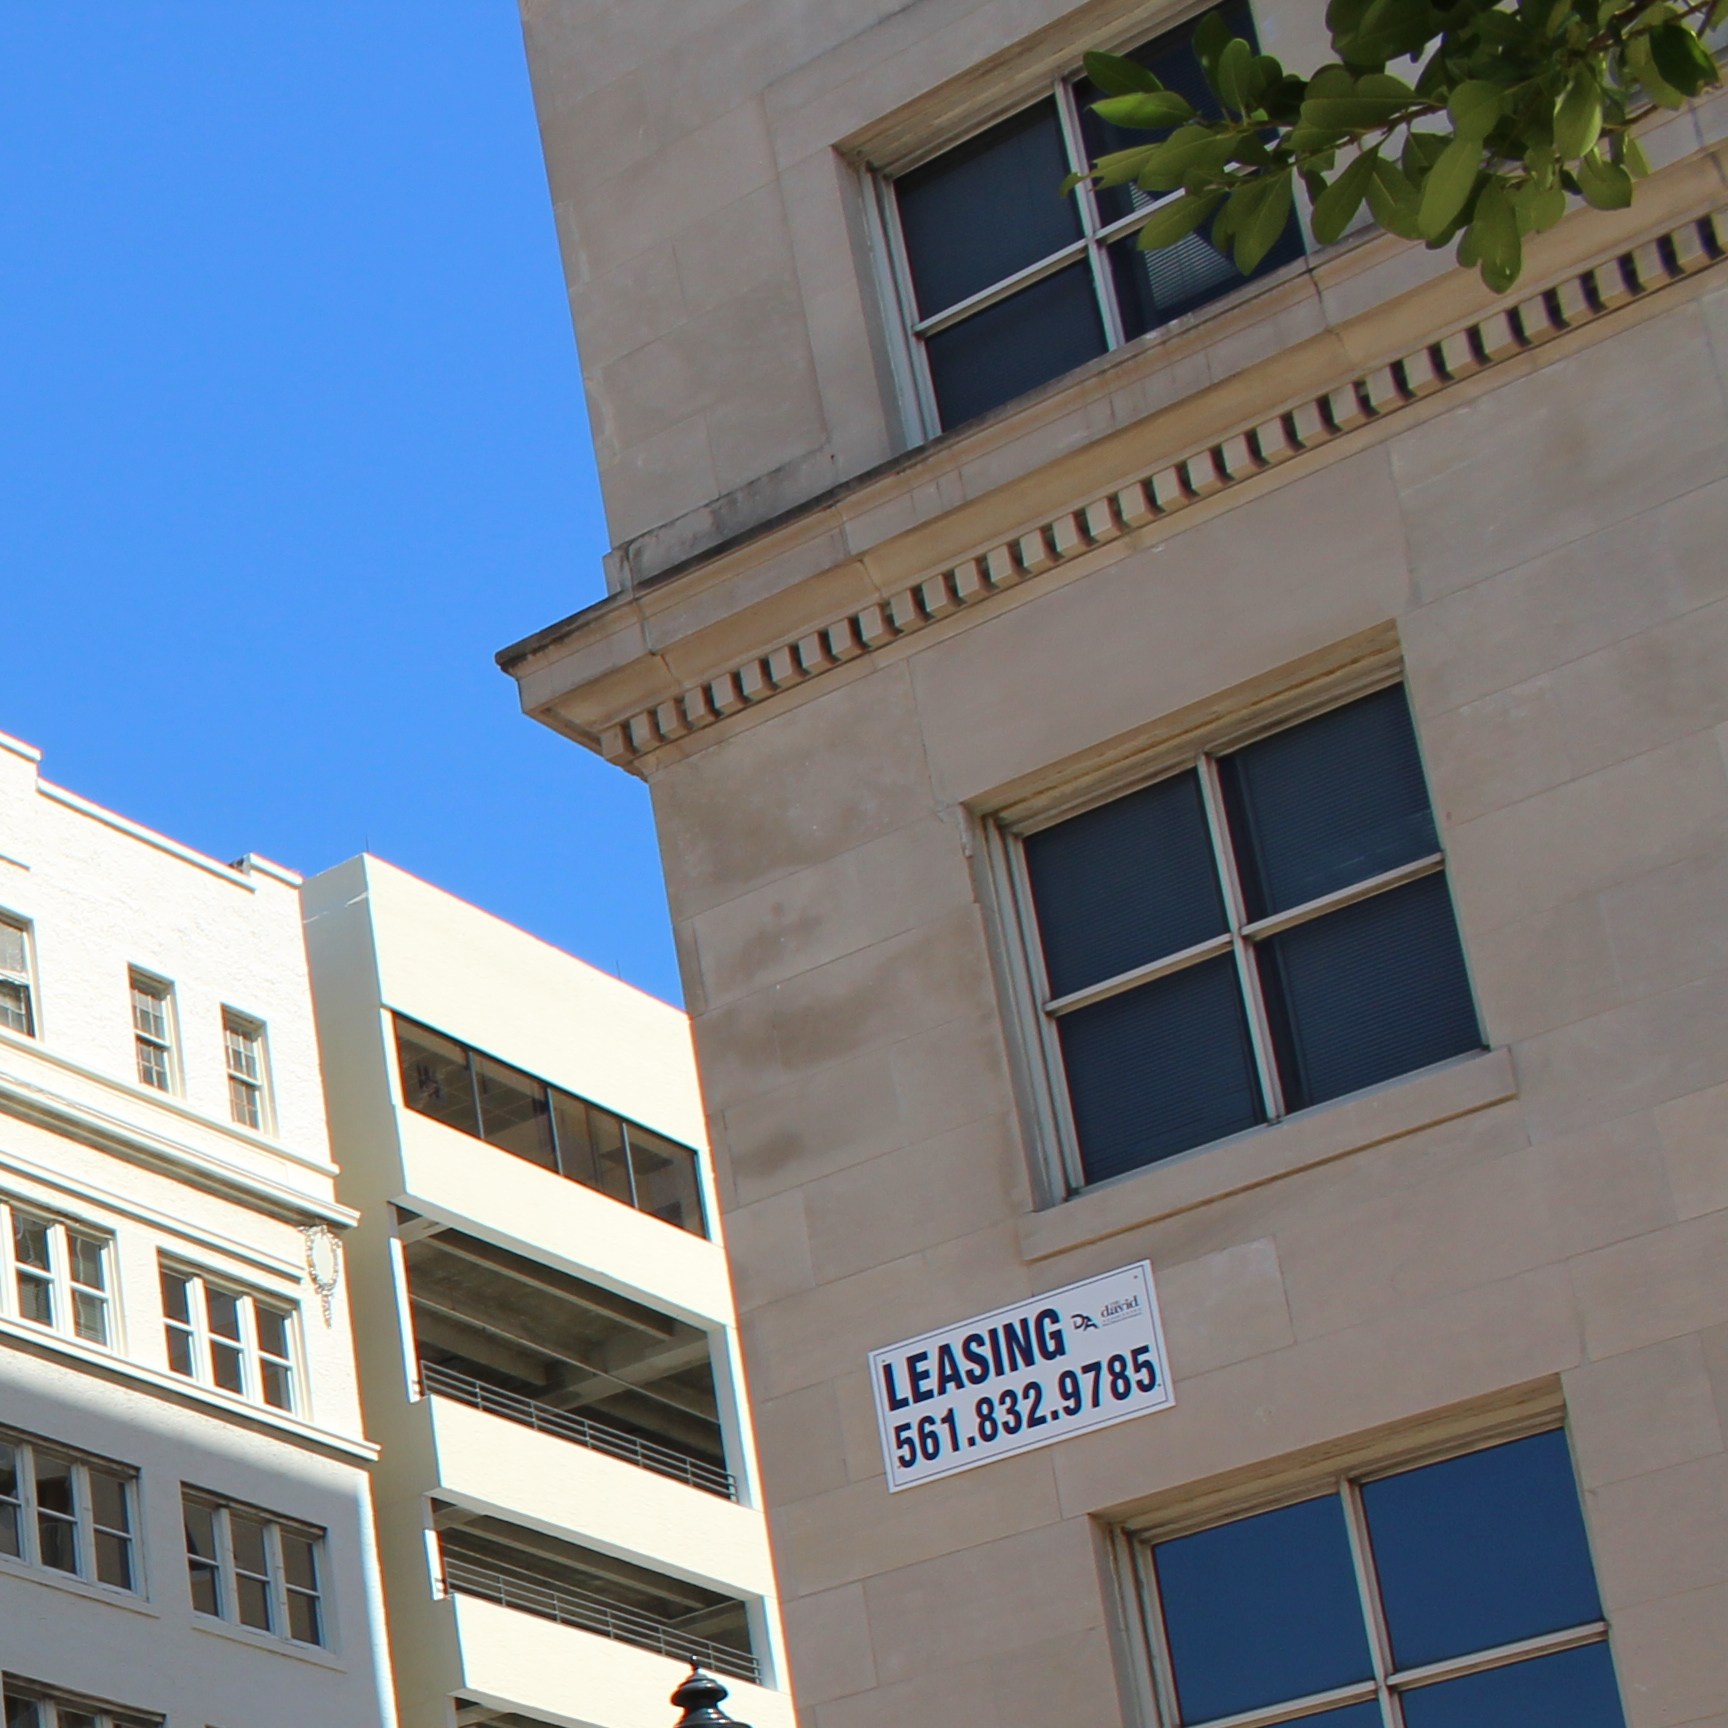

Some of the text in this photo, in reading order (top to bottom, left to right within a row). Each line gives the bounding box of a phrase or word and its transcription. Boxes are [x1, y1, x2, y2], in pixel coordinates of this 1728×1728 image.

[1100, 1295, 1140, 1318] david
[882, 1308, 1066, 1412] LEASING
[893, 1344, 1157, 1469] 561.832.9785
